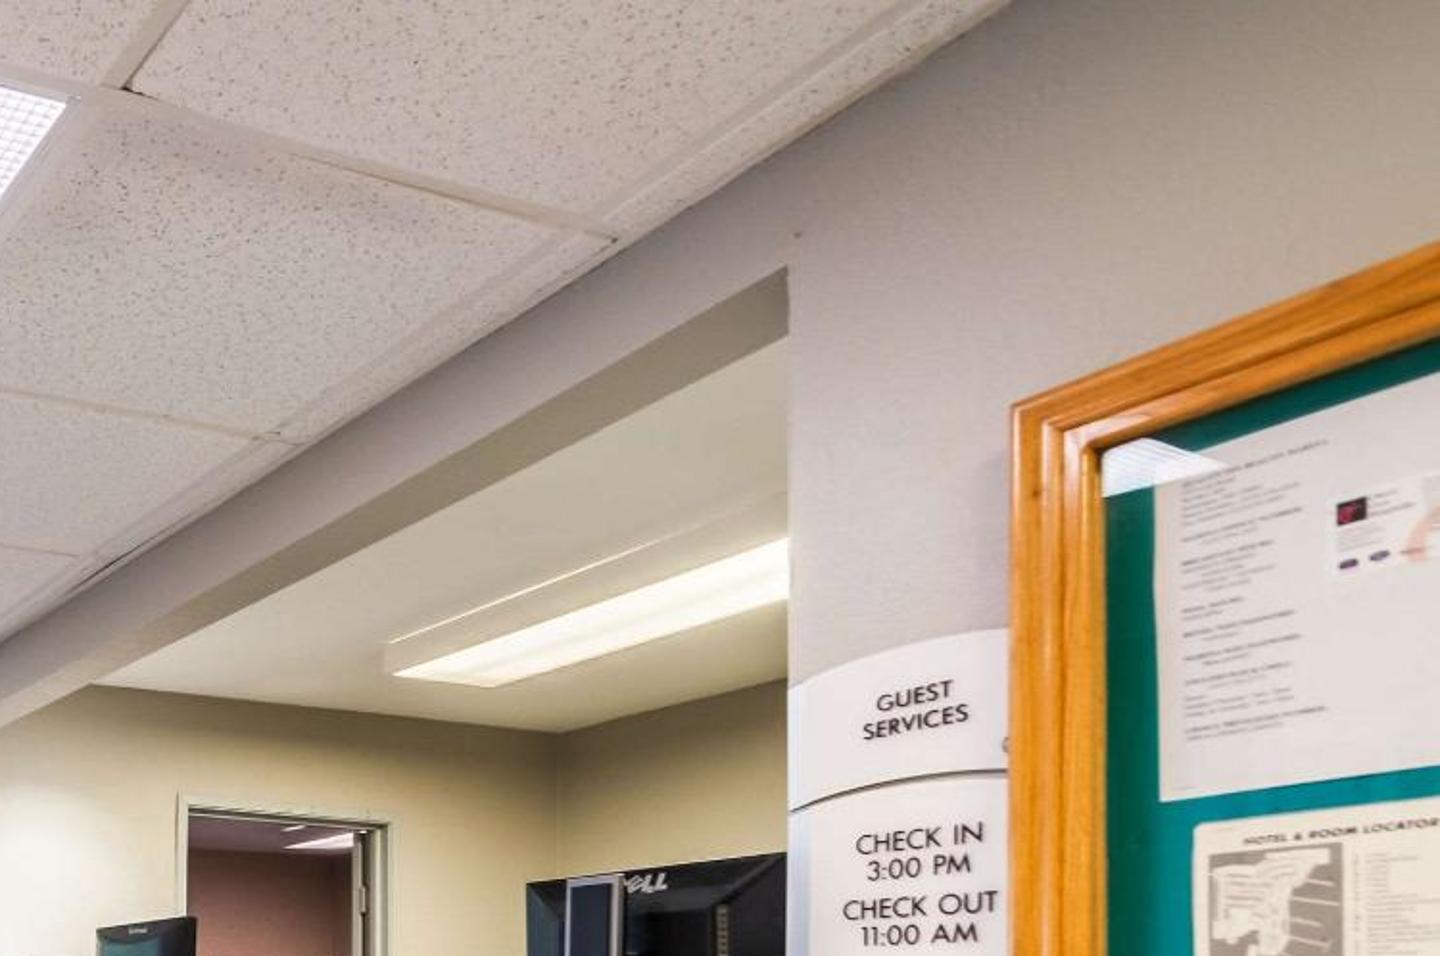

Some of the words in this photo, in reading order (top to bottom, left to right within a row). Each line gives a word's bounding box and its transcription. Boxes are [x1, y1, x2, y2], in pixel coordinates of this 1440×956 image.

[876, 679, 955, 712] GUEST
[863, 704, 969, 740] SERVICES
[855, 826, 941, 855] CHECK
[953, 821, 984, 846] IN
[624, 872, 668, 893] ELL
[866, 857, 921, 882] 3:00
[933, 854, 972, 875] PM
[843, 895, 927, 921] CHECK
[938, 890, 998, 916] OUT
[861, 924, 921, 947] 11:00
[931, 922, 978, 943] AM
